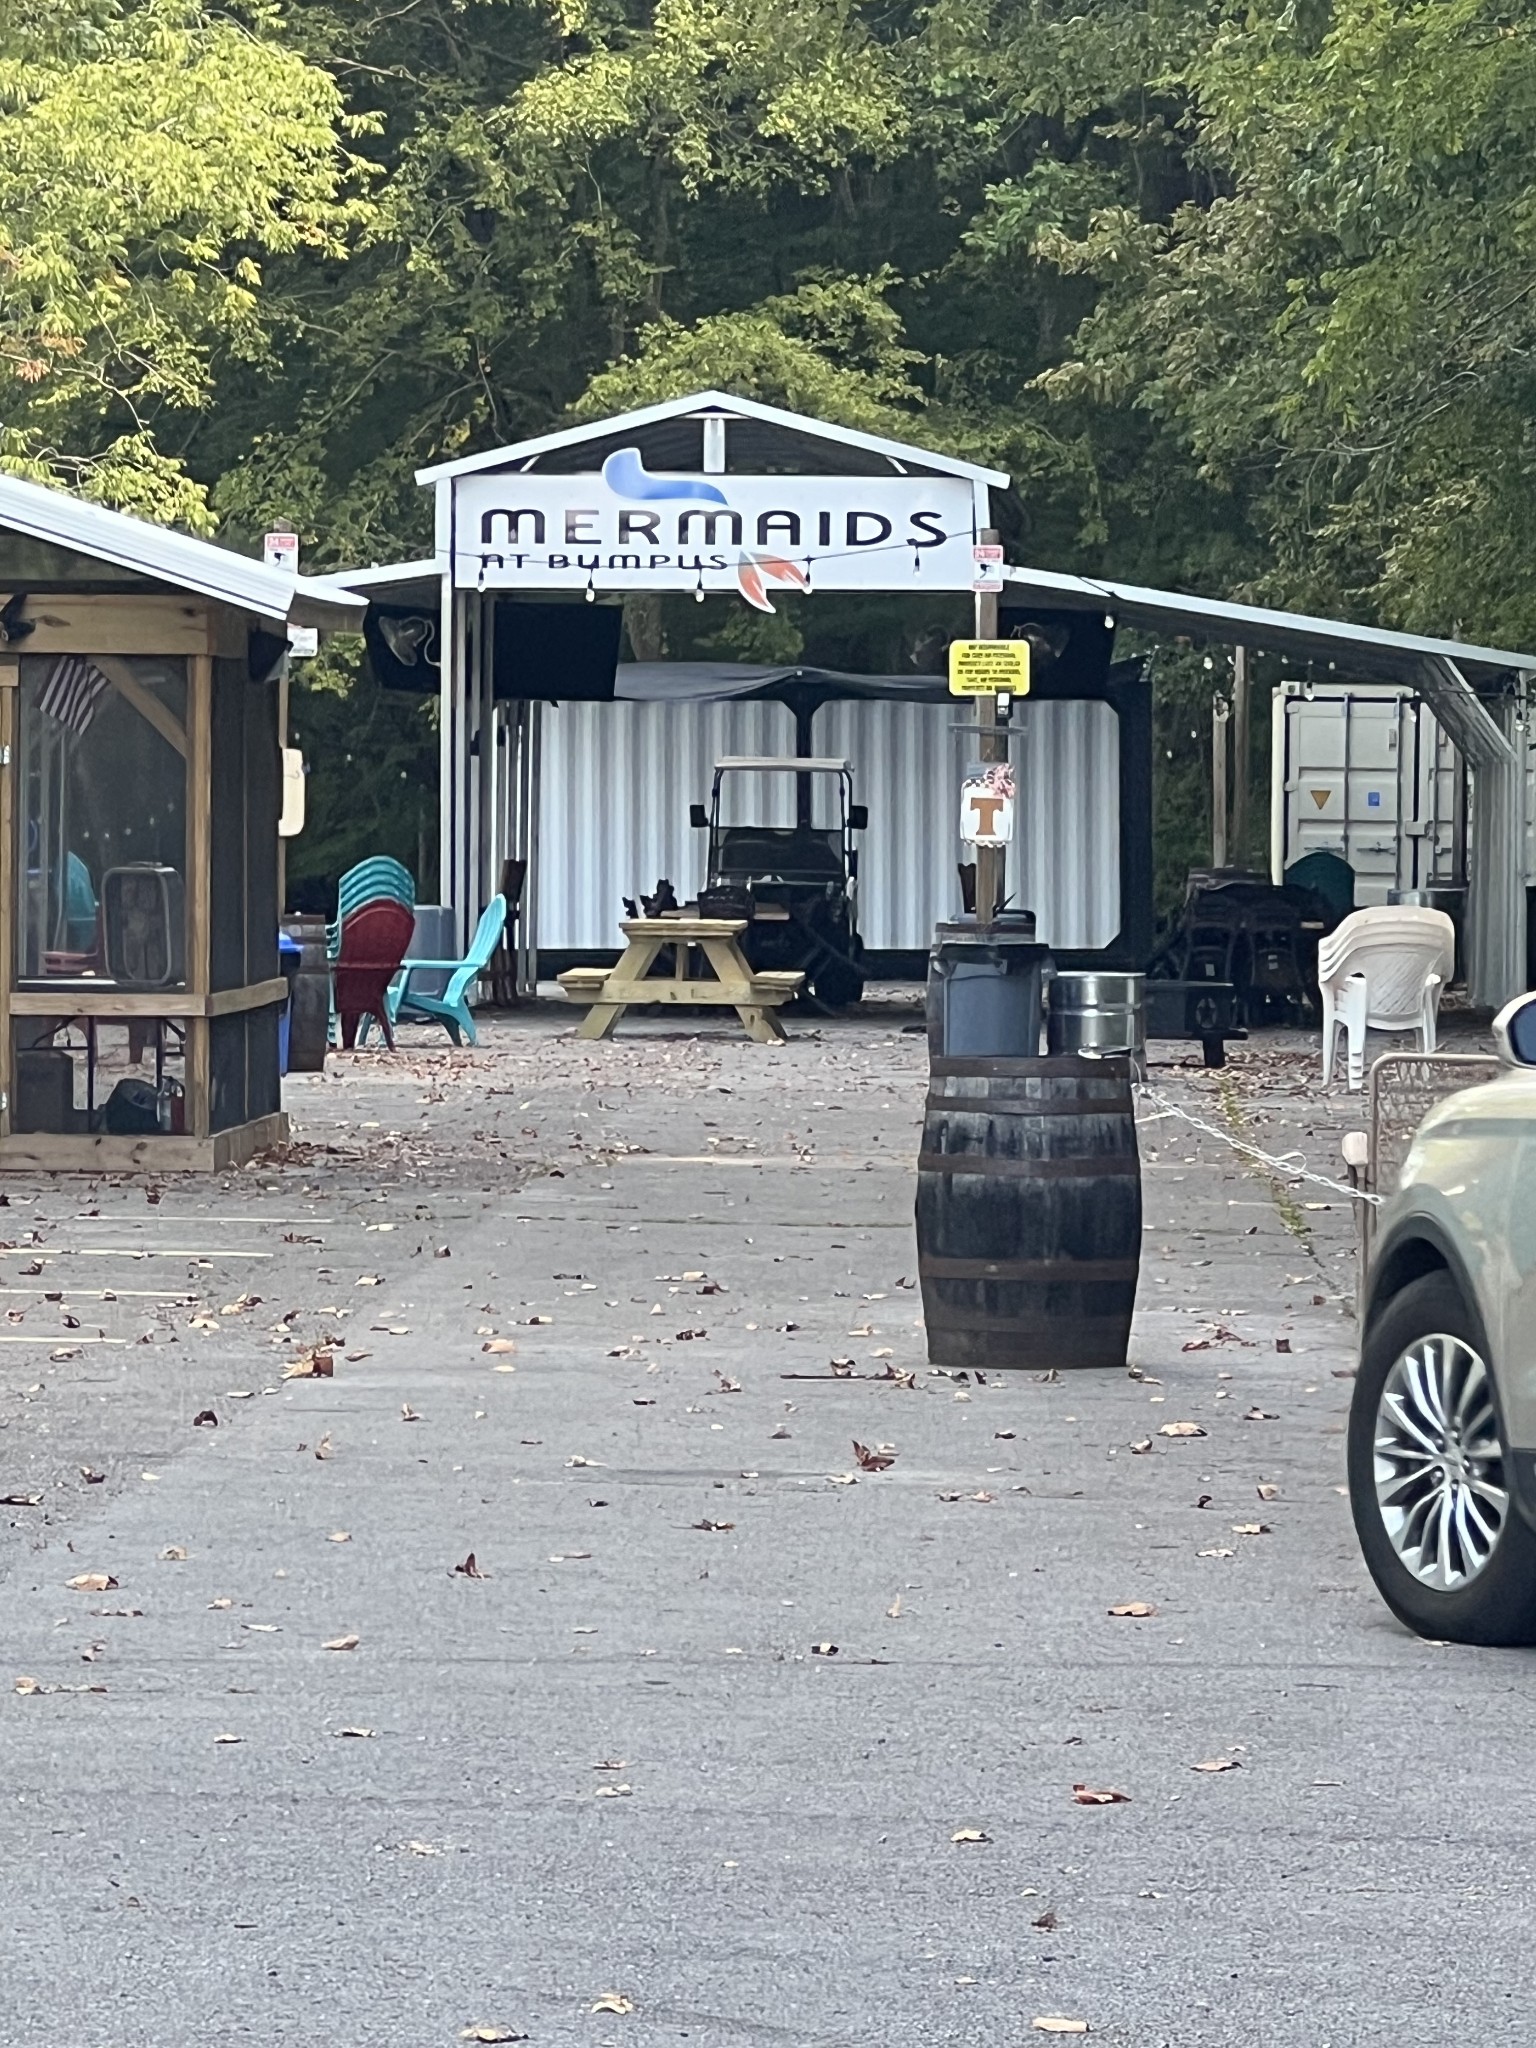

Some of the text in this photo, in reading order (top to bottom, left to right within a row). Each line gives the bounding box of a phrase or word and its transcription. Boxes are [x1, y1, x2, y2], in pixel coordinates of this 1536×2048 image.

[480, 508, 947, 547] MERMAIDS
[483, 553, 728, 570] AT BUMPUS
[970, 797, 1004, 836] T
